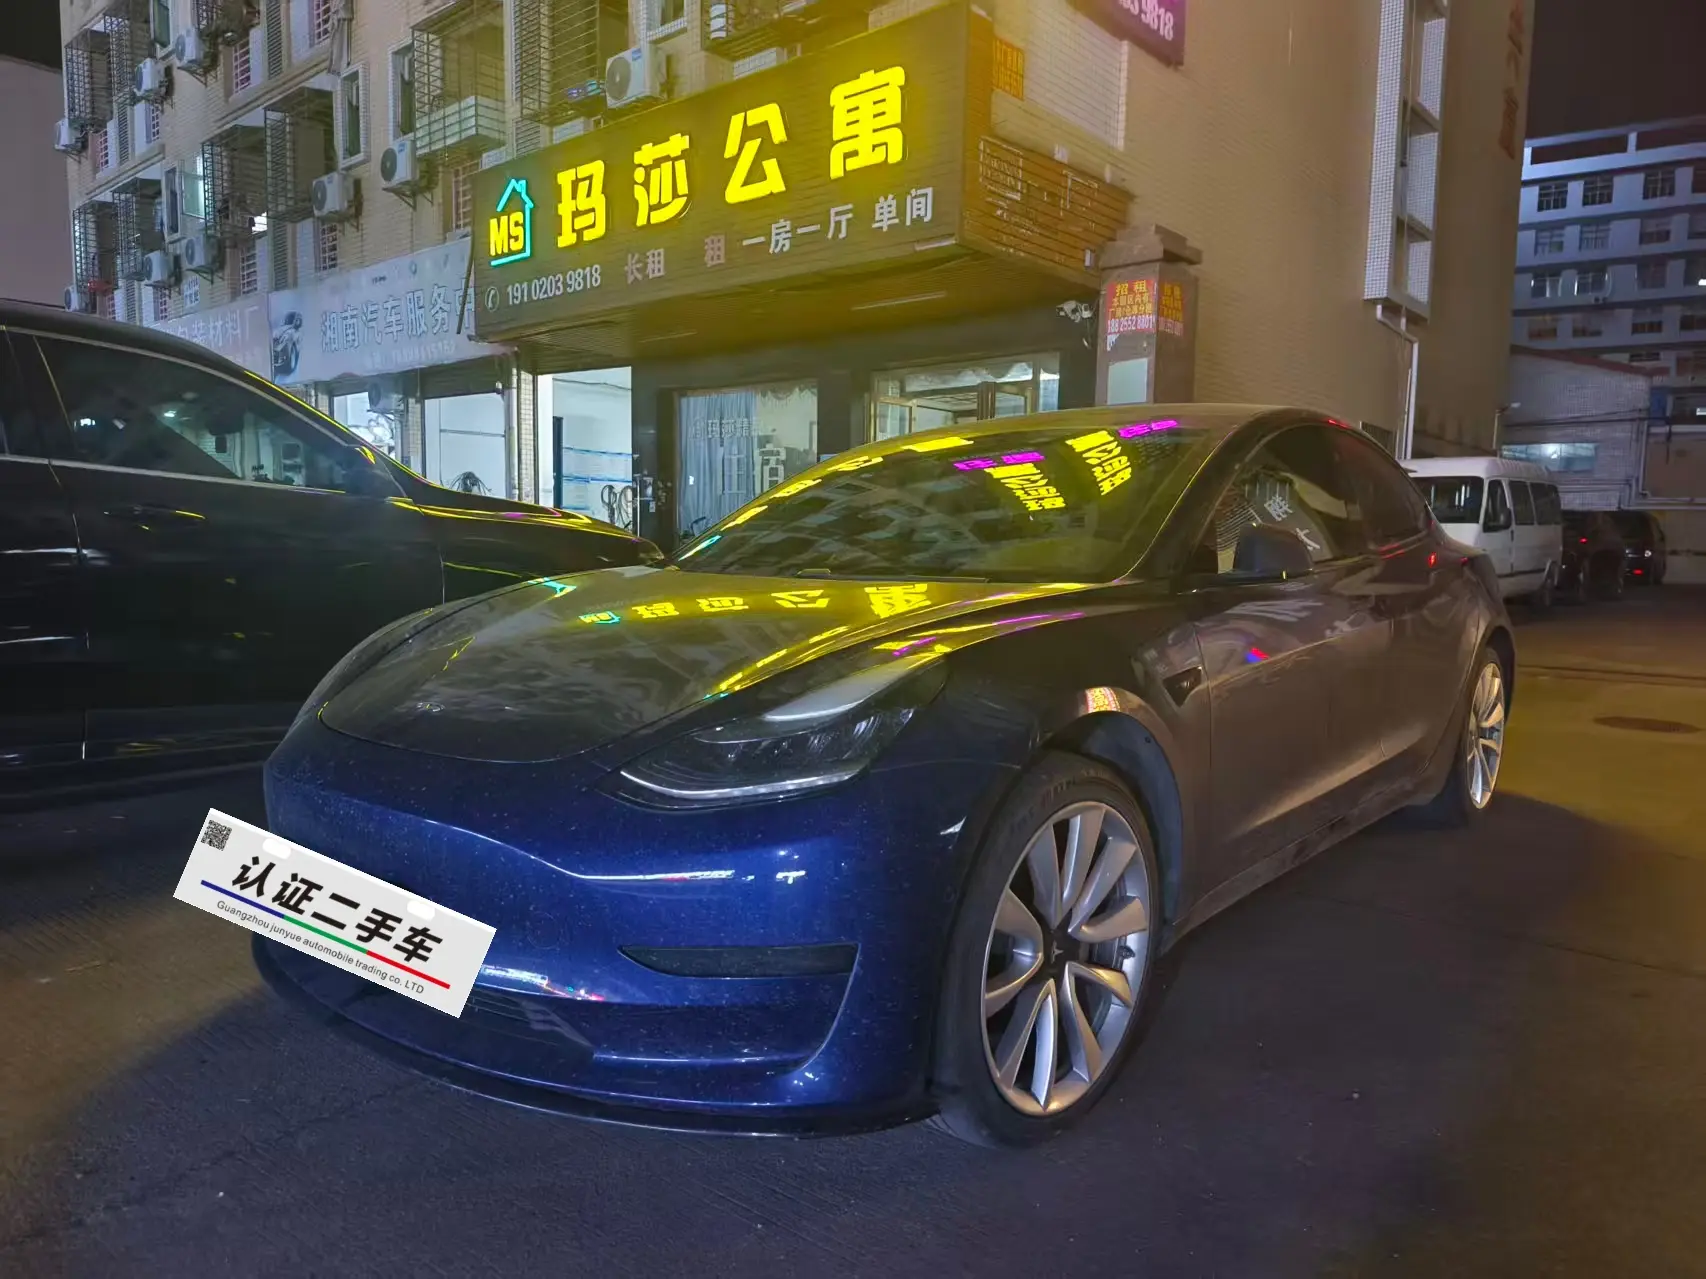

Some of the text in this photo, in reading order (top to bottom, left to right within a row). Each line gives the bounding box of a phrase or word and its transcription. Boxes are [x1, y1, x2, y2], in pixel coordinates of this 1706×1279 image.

[557, 66, 905, 248] 玛莎公寓
[490, 211, 524, 256] MS
[624, 248, 665, 284] 长租
[742, 203, 853, 254] 一房一厅
[871, 186, 933, 232] 单间
[507, 264, 601, 305] 191 0203 9818
